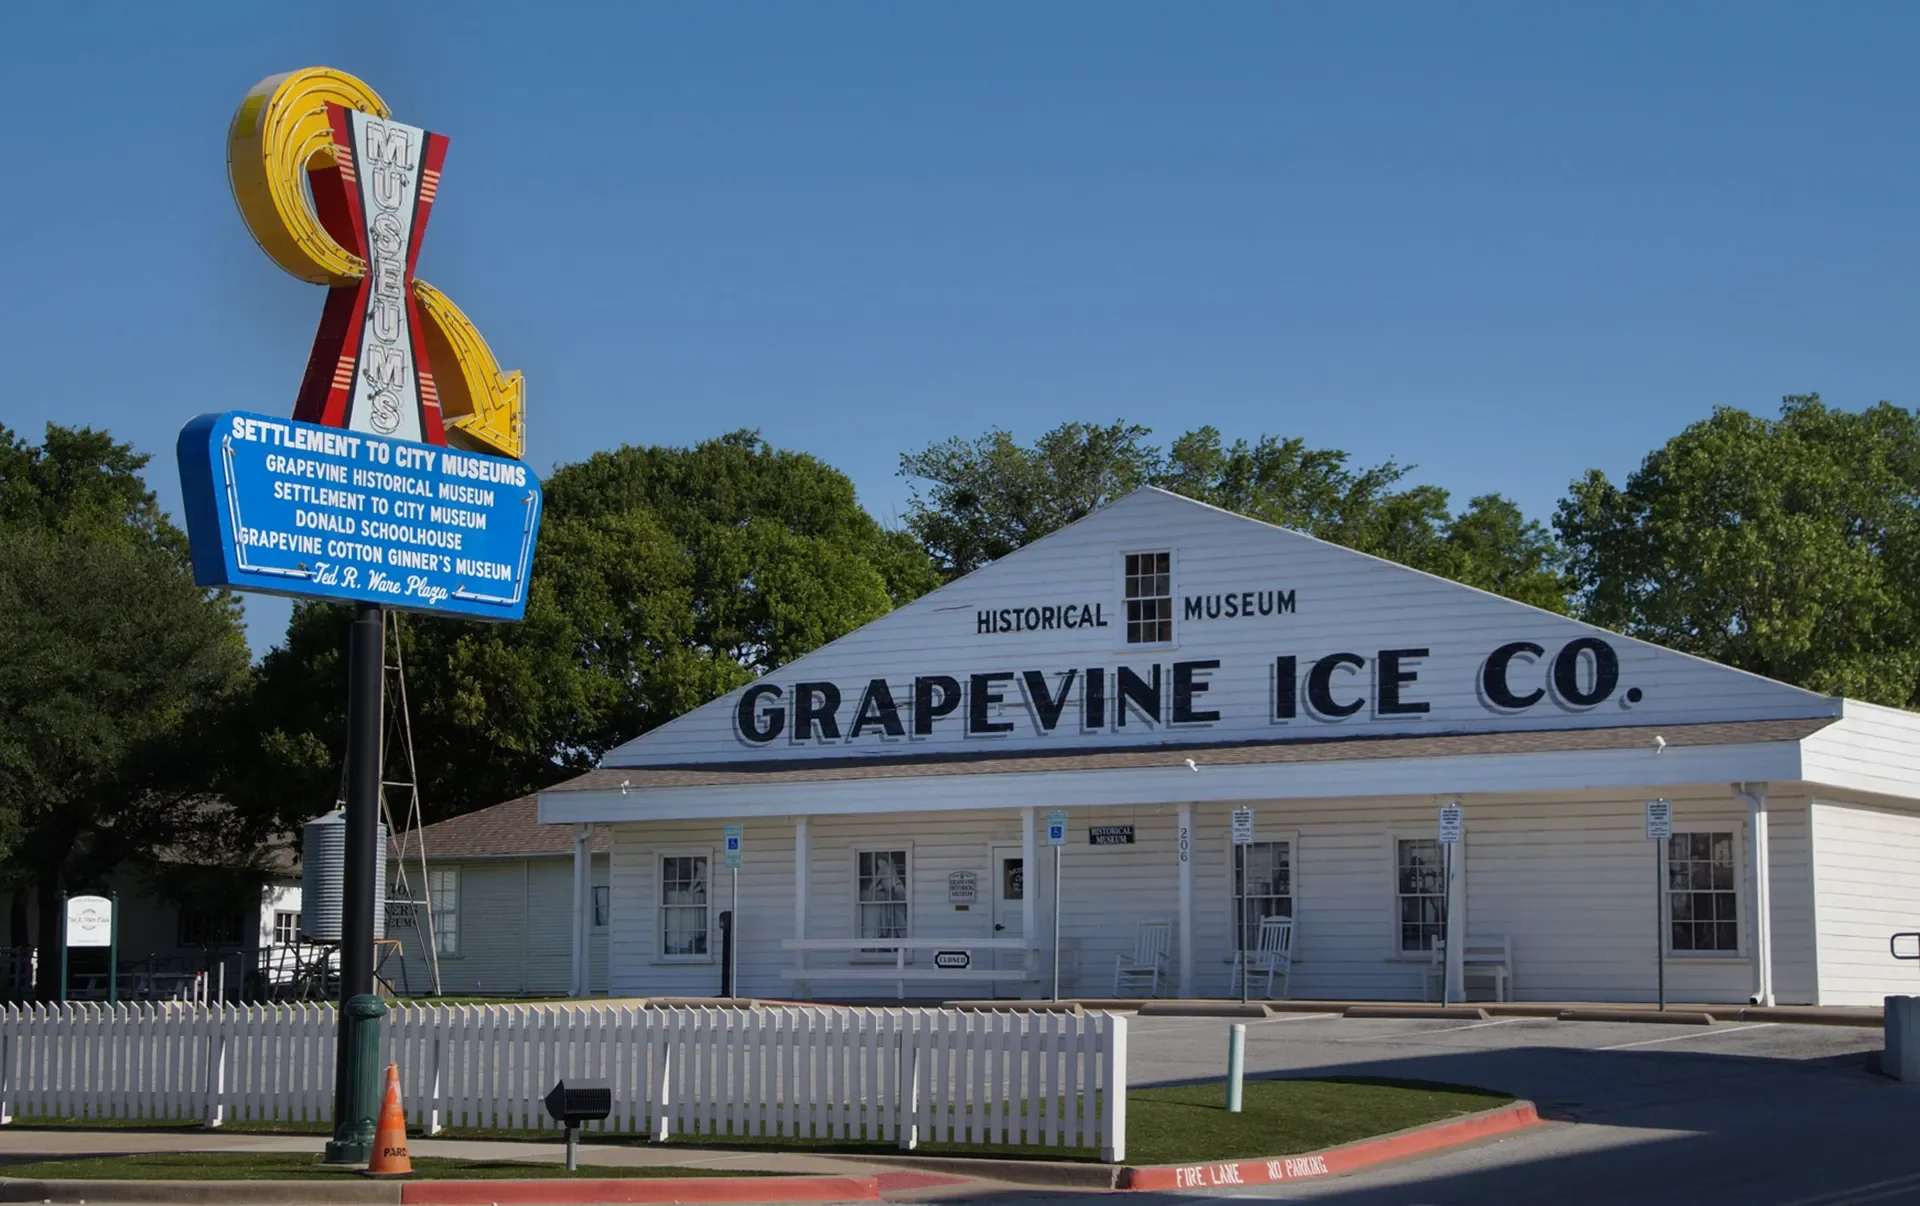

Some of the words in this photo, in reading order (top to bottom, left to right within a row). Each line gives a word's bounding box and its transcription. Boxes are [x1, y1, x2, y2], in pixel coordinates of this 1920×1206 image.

[366, 120, 414, 435] MUSEUMS
[231, 416, 359, 459] SETTLEMENT
[366, 441, 390, 464] TO
[396, 447, 436, 471] CITY
[441, 454, 526, 487] MUSEUMS
[266, 454, 347, 484] GRAPEVINE
[353, 469, 433, 498] HISTORICAL
[439, 482, 494, 507] MUSEUM
[274, 481, 365, 512] SETTLEMENT
[371, 496, 389, 515] TO
[394, 500, 424, 521] CITY
[430, 505, 487, 530] MUSEUM
[295, 509, 355, 535] DONALD
[361, 519, 463, 550] SCHOOLHOUSE
[238, 527, 322, 555] GRAPEVINE
[327, 541, 382, 564] COTTON
[388, 548, 451, 573] GINNER'S
[456, 557, 511, 582] MUSEUM
[312, 562, 339, 586] Ted
[341, 566, 361, 589] R.
[367, 569, 401, 594] Ware
[404, 575, 448, 604] Plaza
[977, 603, 1108, 634] HISTORICAL
[1185, 590, 1297, 621] MUSEUM
[733, 659, 1222, 747] GRAPEVINE
[1269, 647, 1431, 725] ICE
[1475, 637, 1643, 715] CO.
[1091, 826, 1132, 836] HISTORICAL
[1096, 834, 1128, 844] MUSEUM
[1180, 827, 1188, 862] 206
[940, 956, 966, 964] CLOSED
[1176, 1166, 1206, 1188] FIRE
[1210, 1163, 1244, 1185] LANE
[1266, 1160, 1283, 1180] NO
[1285, 1156, 1328, 1178] PARKING
